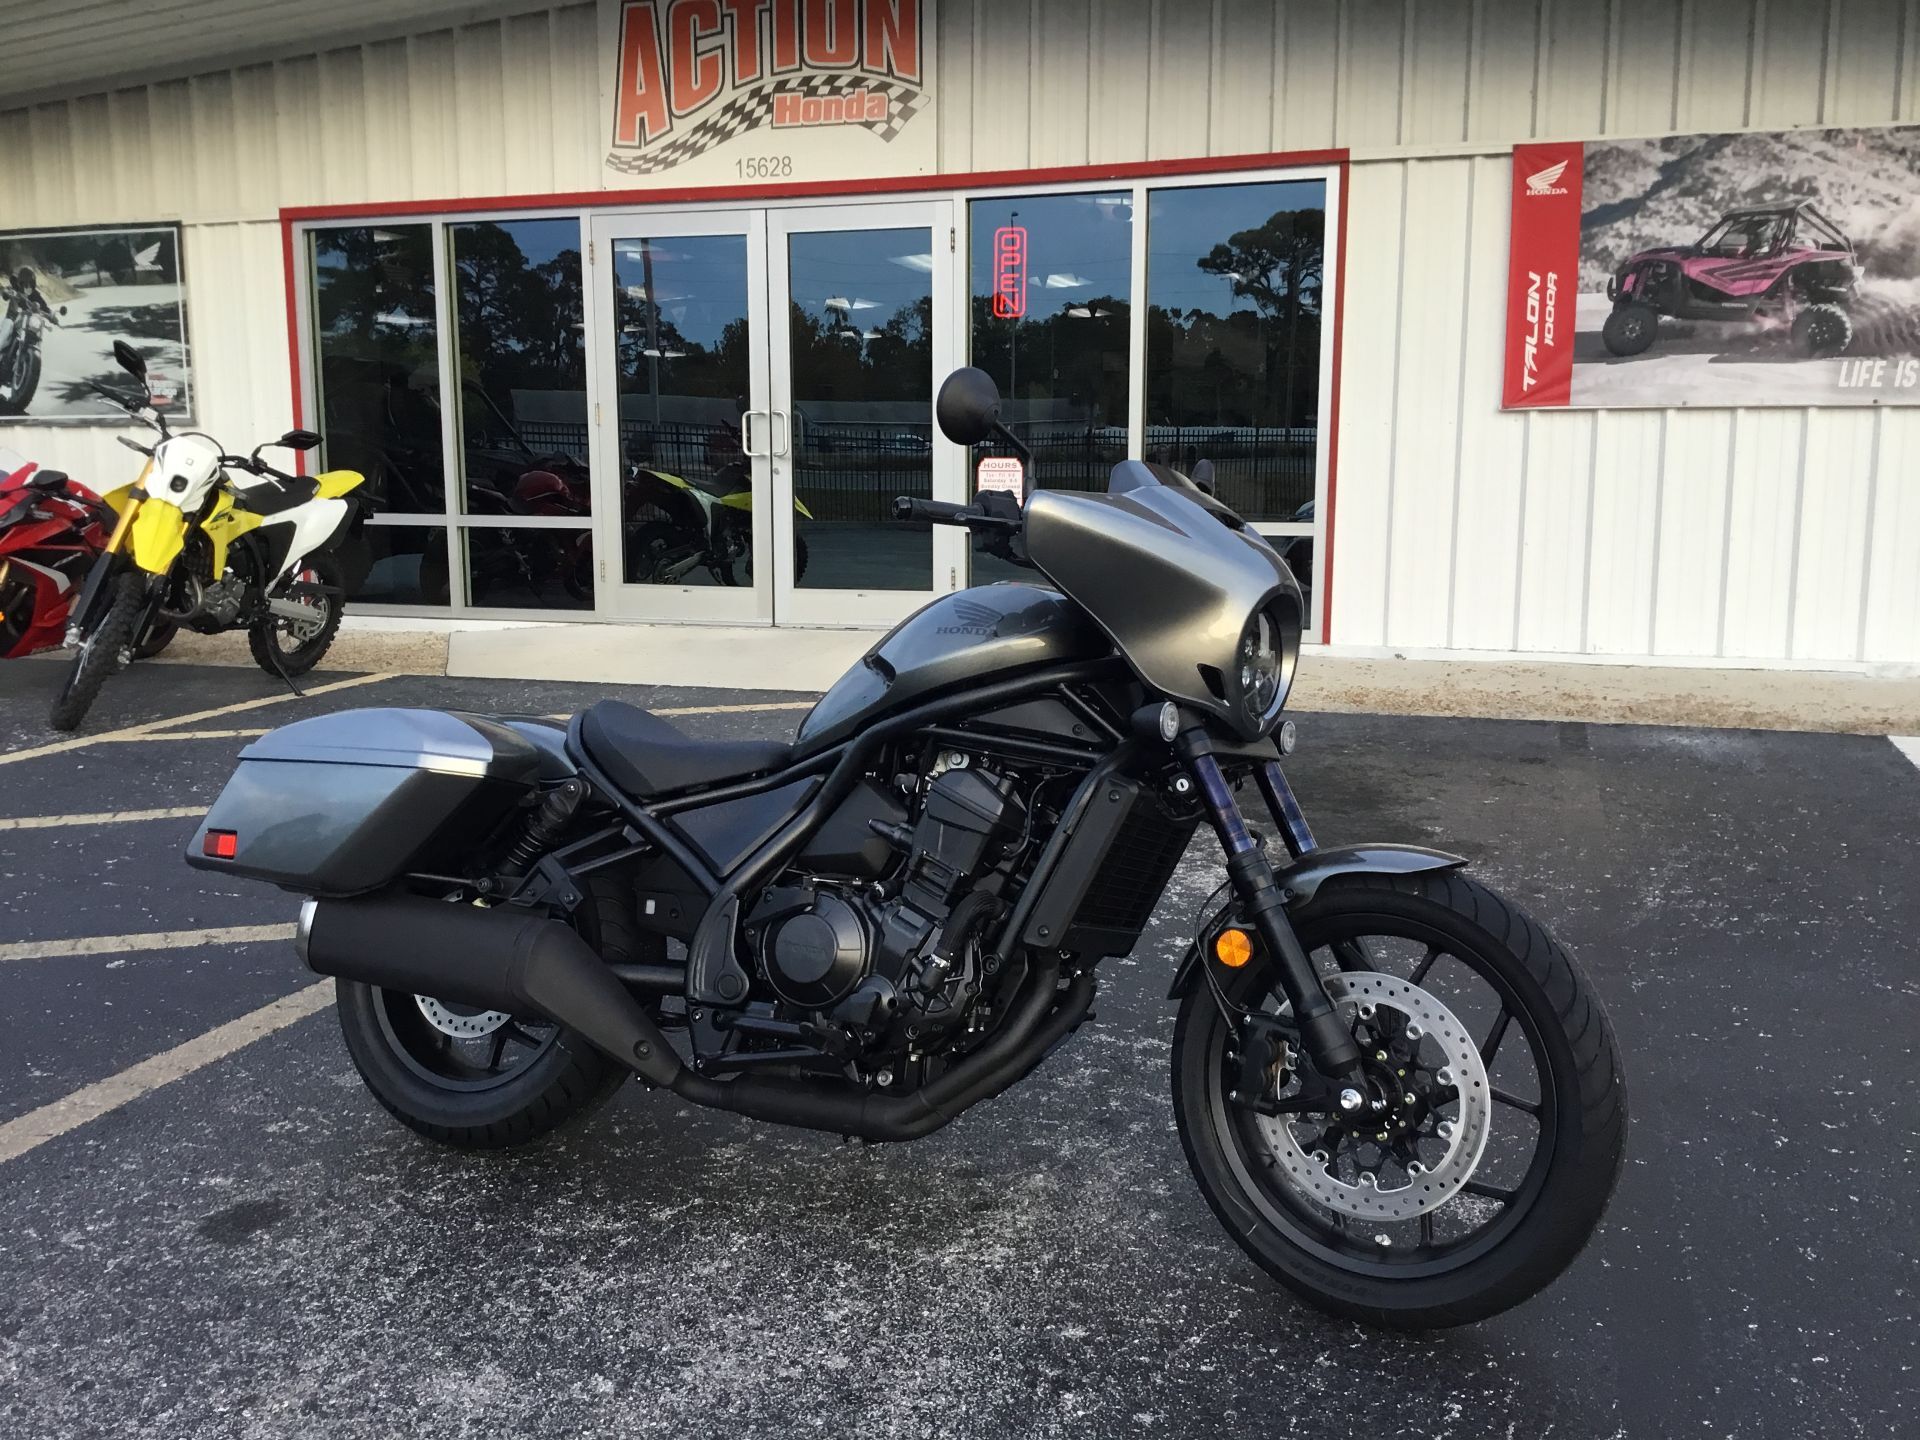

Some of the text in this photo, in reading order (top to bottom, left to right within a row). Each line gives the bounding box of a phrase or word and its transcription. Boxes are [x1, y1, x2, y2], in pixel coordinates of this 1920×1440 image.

[612, 0, 923, 149] ACTION
[772, 86, 889, 128] Honda
[735, 156, 793, 179] 15628
[1526, 186, 1568, 196] HONDA
[1000, 234, 1020, 312] OPEN
[1522, 271, 1542, 392] TALON
[1544, 271, 1558, 346] 1000R
[1838, 360, 1920, 388] LIFE IS
